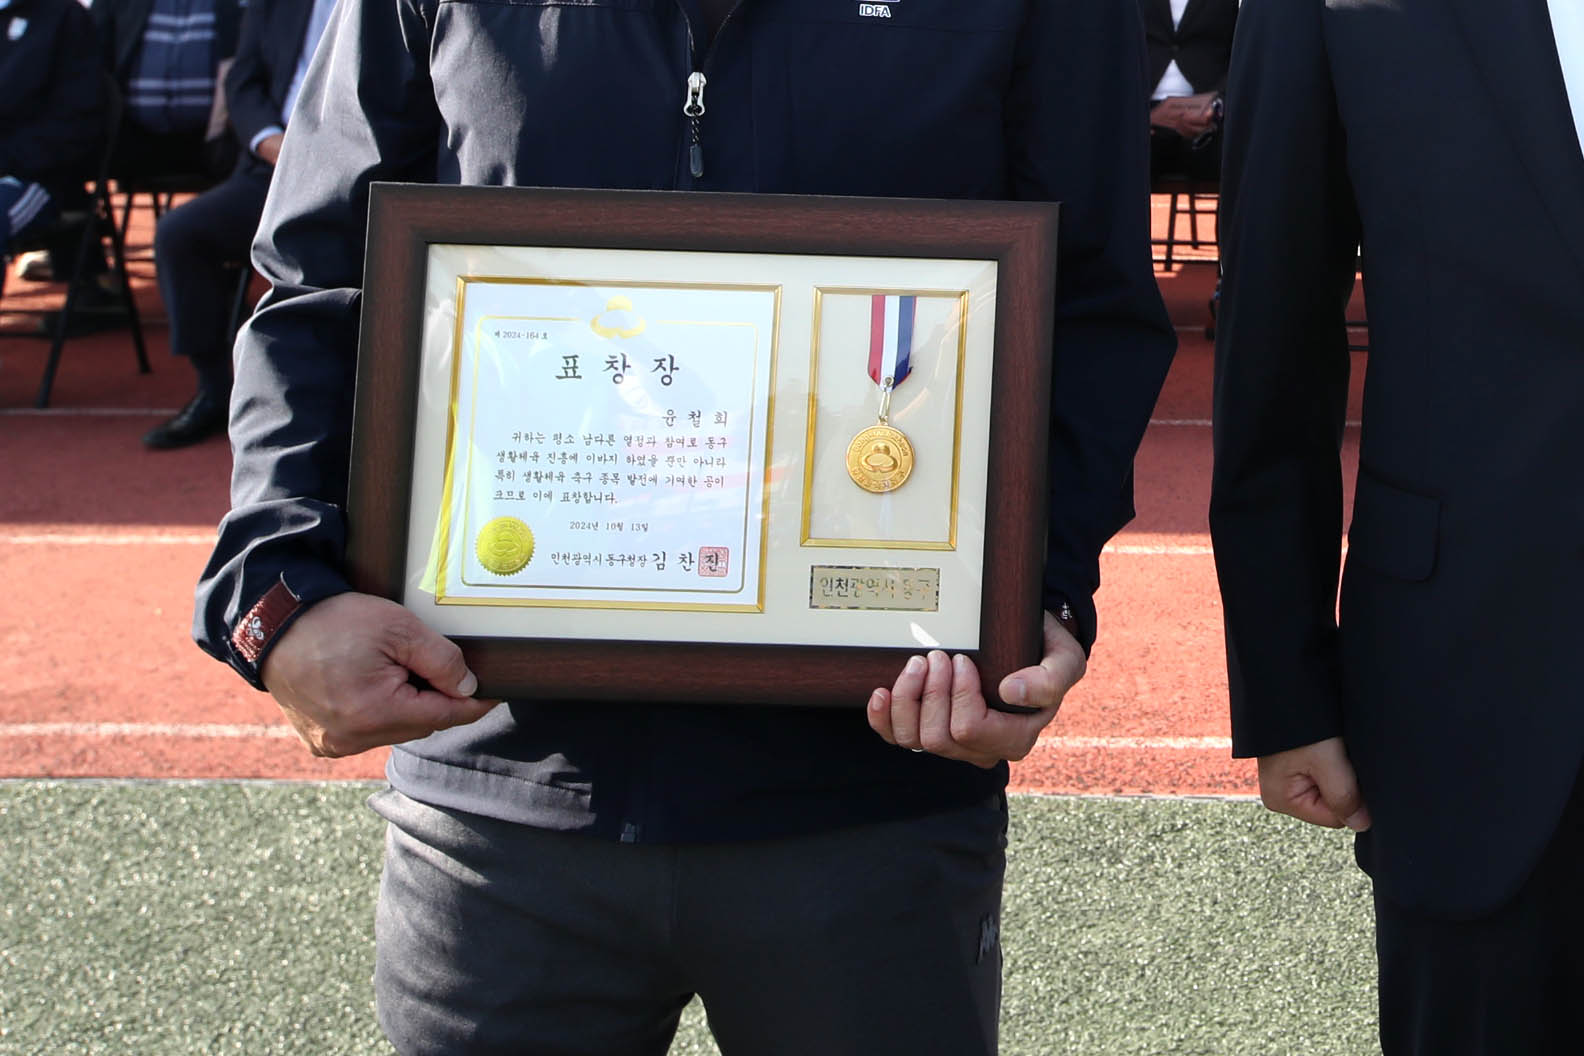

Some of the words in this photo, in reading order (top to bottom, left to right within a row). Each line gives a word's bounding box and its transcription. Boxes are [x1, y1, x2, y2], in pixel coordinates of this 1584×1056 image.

[858, 2, 891, 19] IDFA
[512, 431, 545, 444] 귀하는
[584, 433, 615, 446] 남다른
[705, 437, 727, 449] 동구
[497, 450, 539, 463] 생활체육
[547, 452, 577, 464] 진흥에
[586, 453, 617, 464] 이바지
[694, 456, 725, 468] 아니라
[495, 469, 515, 482] 특히
[523, 471, 565, 483] 생활체육
[571, 472, 592, 483] 축구
[599, 473, 620, 485] 종목
[627, 472, 657, 486] 발전에
[665, 475, 697, 487] 기여한
[704, 476, 723, 488] 공이
[494, 490, 525, 500] 크므로
[533, 490, 552, 502] 이에
[560, 491, 617, 504] 표창합니다.
[570, 521, 598, 531] 2024년
[606, 522, 623, 531] 10월
[632, 523, 648, 532] 13일
[551, 552, 601, 565] 인천광역시
[606, 554, 647, 567] 동구청장
